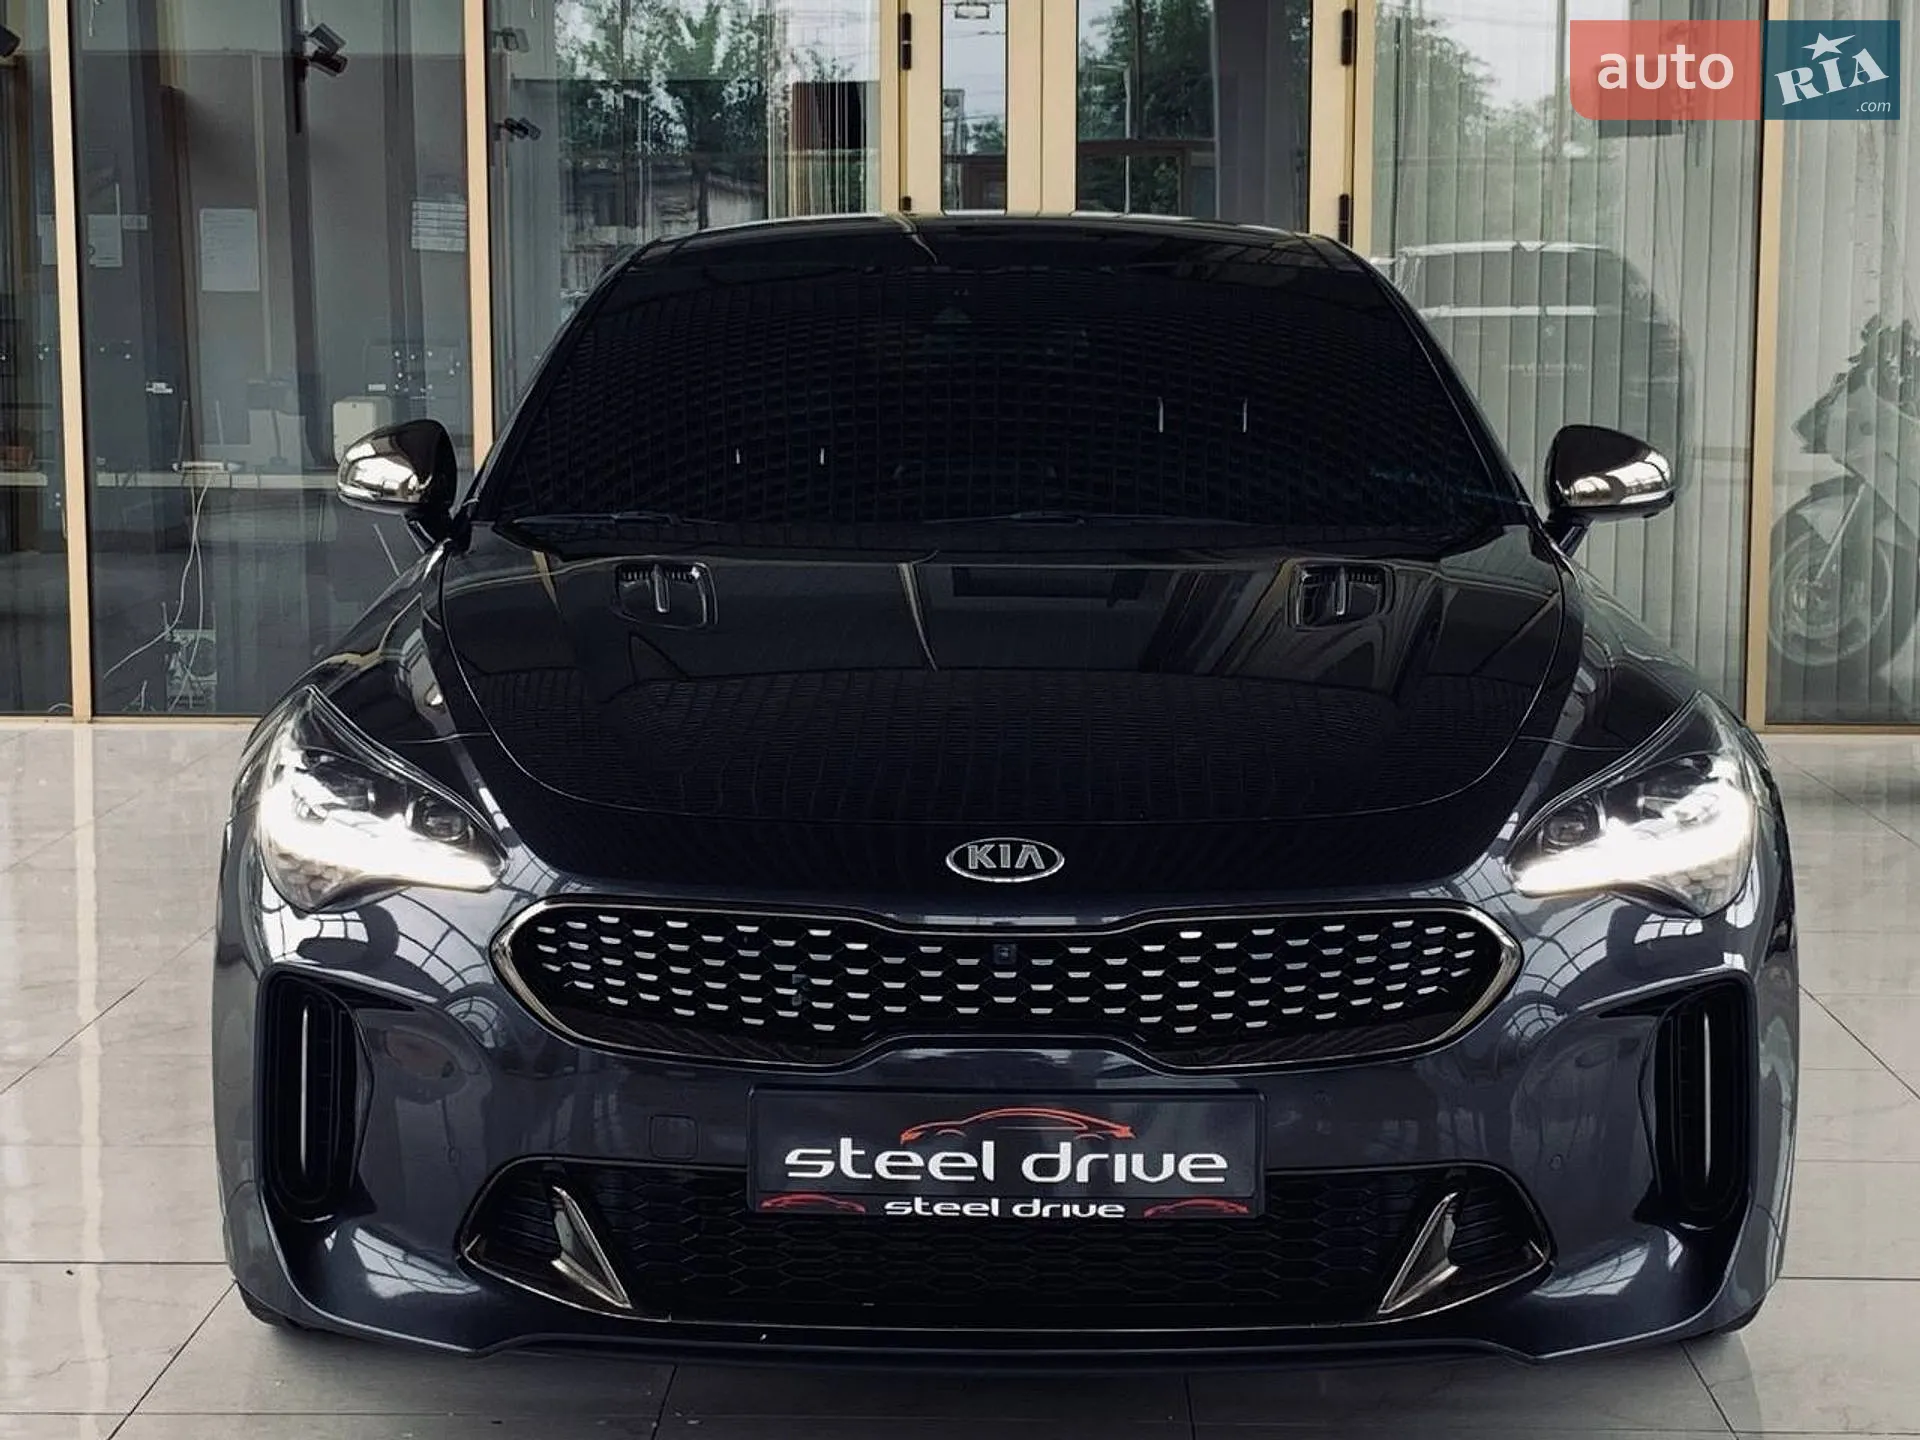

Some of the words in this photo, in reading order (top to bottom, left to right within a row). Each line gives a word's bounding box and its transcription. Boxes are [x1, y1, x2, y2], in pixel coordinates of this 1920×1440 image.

[967, 844, 1046, 870] KIA
[784, 1137, 995, 1181] steel
[1021, 1141, 1229, 1184] drive
[884, 1197, 999, 1217] steel
[1012, 1198, 1126, 1219] drive
